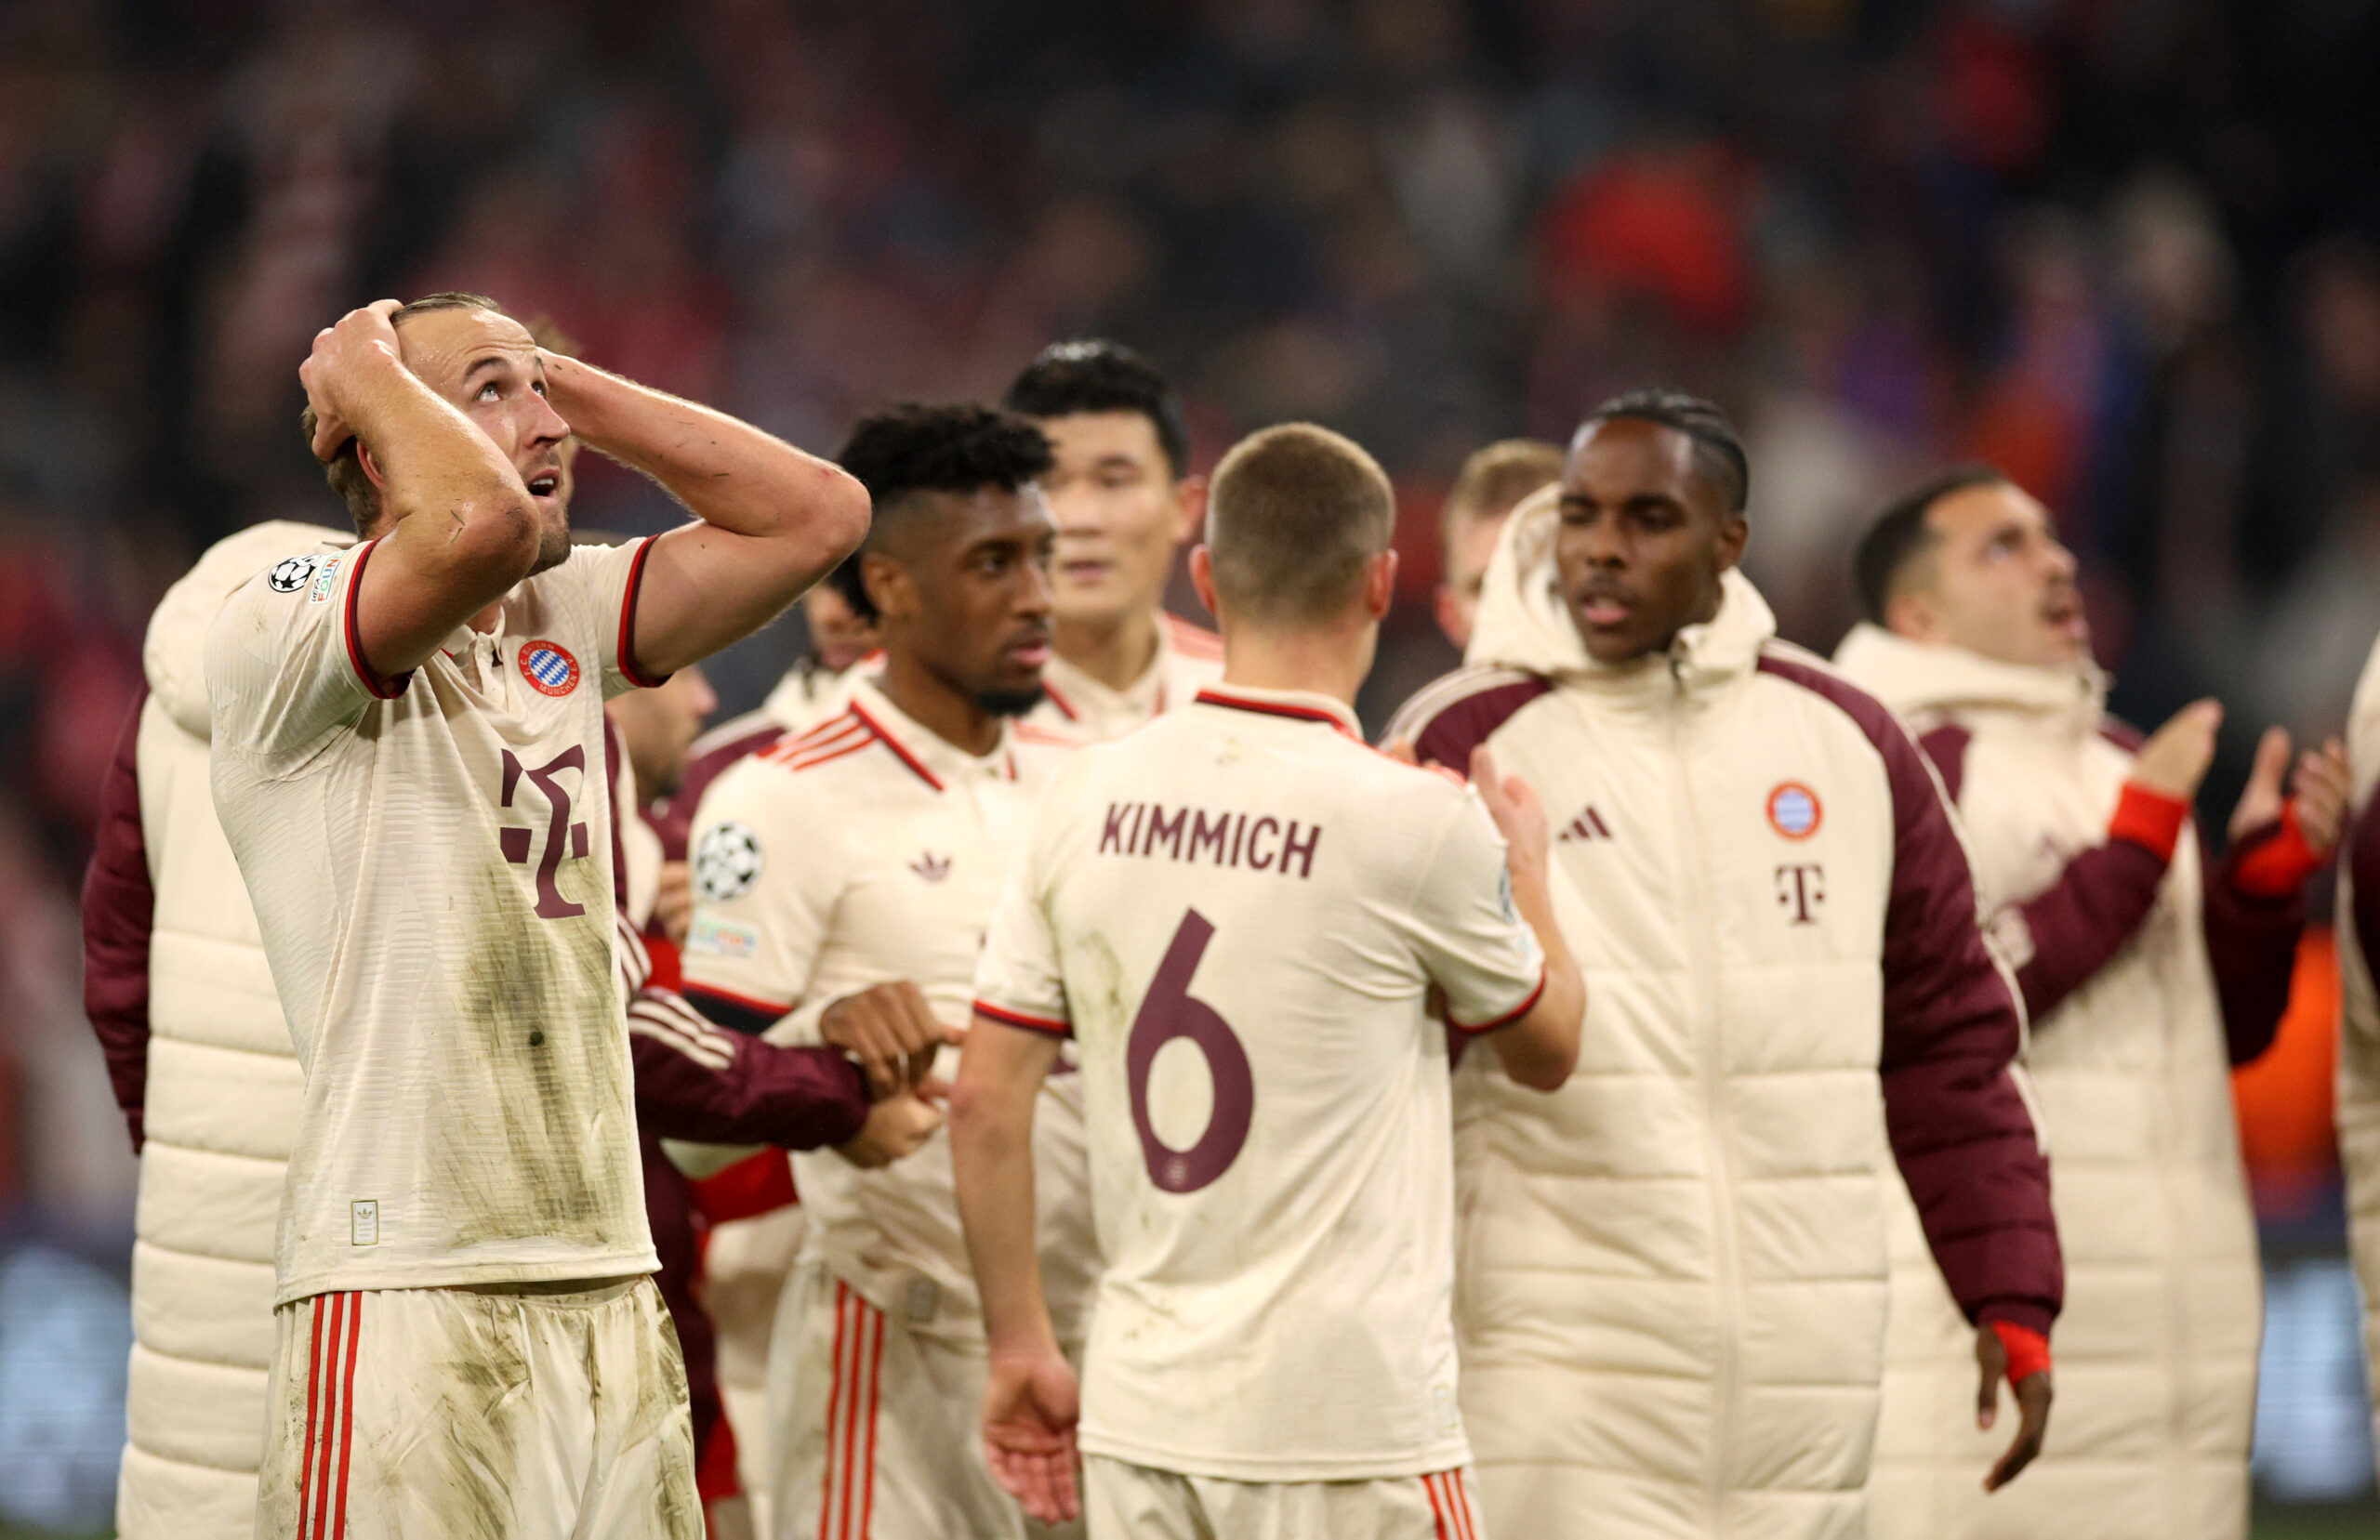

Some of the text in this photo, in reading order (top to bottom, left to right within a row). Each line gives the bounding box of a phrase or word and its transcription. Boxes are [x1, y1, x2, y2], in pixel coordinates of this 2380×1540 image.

[311, 578, 321, 602] UEFA
[1099, 802, 1322, 879] KIMMICH
[1775, 862, 1825, 926] T
[1127, 907, 1255, 1194] 6
